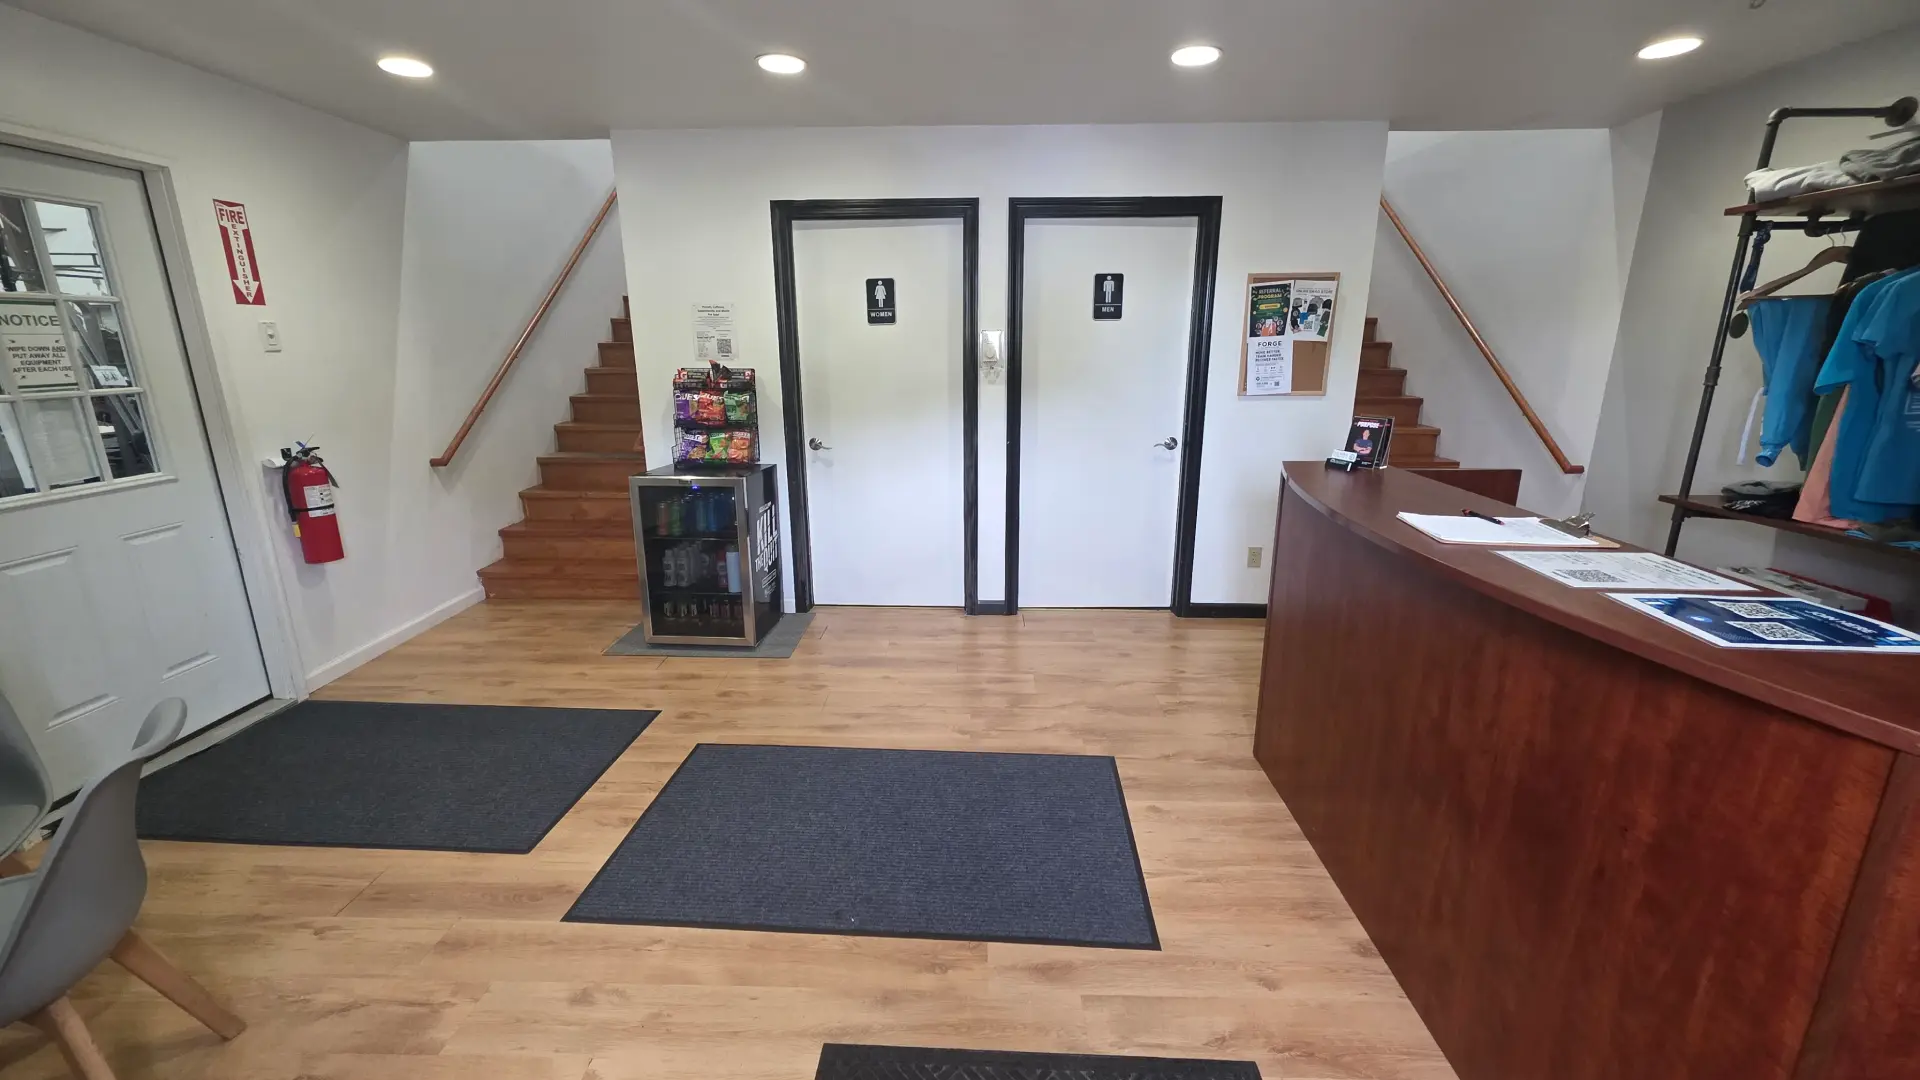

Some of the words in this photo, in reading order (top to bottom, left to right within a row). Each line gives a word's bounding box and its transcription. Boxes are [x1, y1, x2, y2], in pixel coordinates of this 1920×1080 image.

[218, 207, 245, 225] FIRE
[231, 223, 253, 298] EXTINGUISHER
[0, 314, 61, 327] NOTICE
[51, 345, 67, 353] AND
[756, 503, 778, 556] KILL
[763, 533, 779, 573] QUIT
